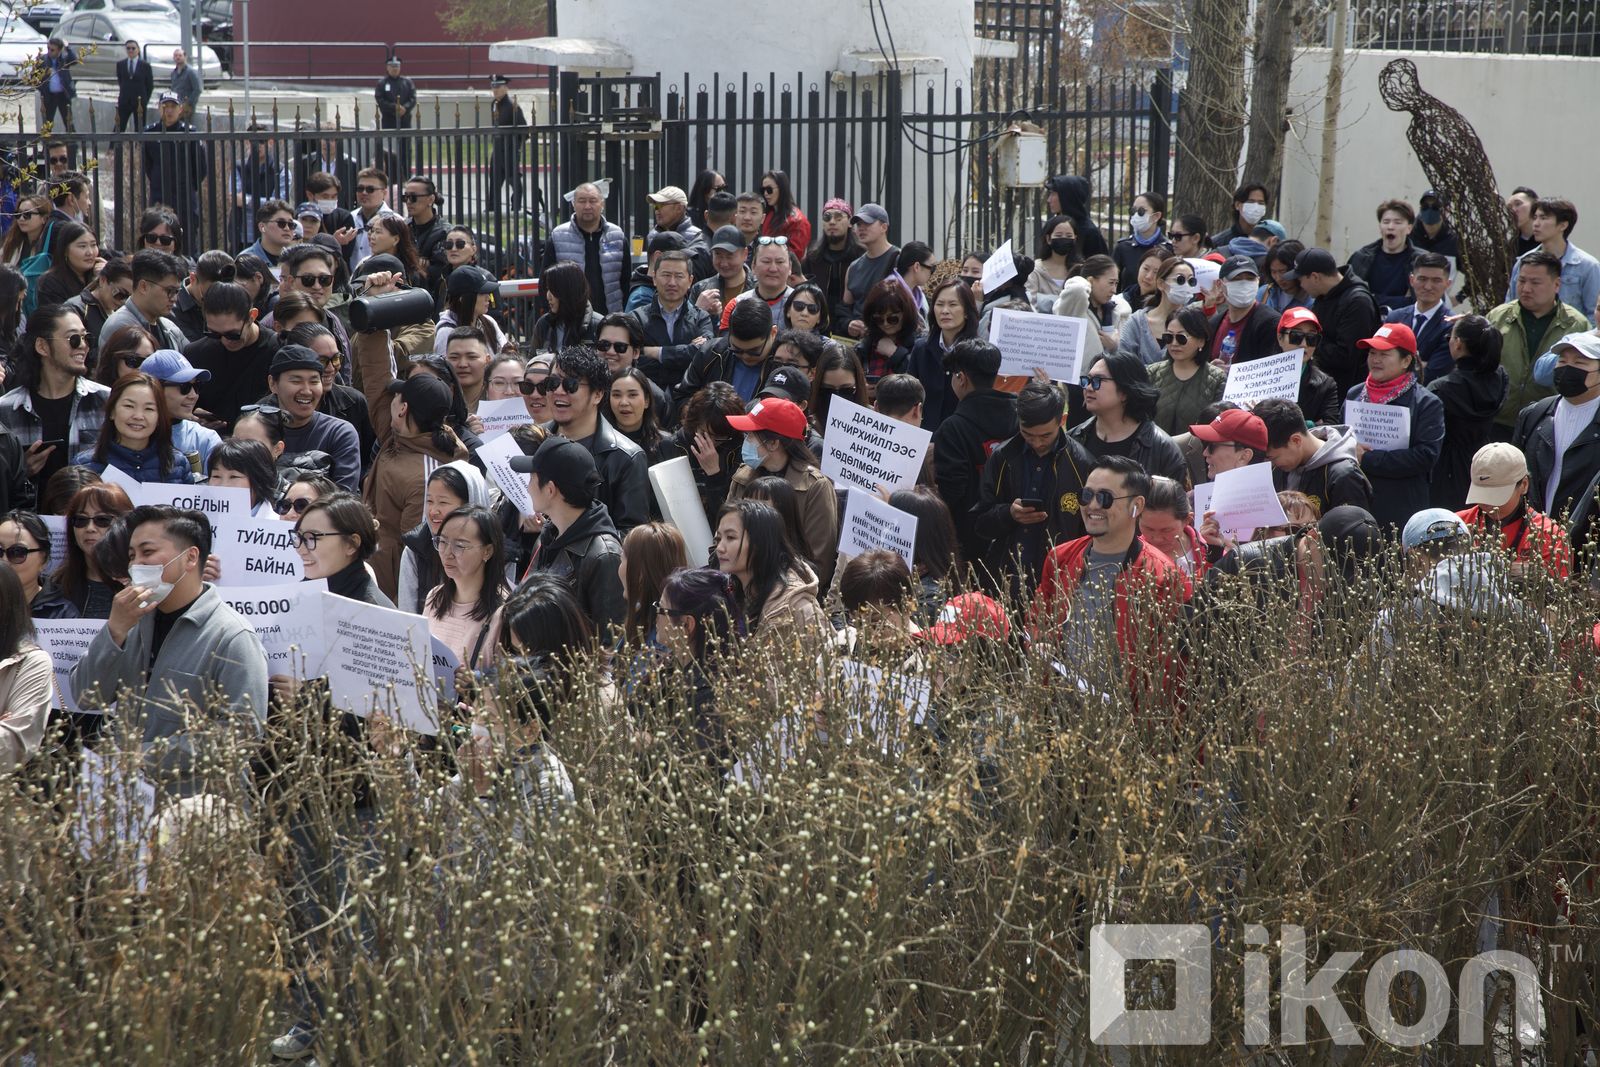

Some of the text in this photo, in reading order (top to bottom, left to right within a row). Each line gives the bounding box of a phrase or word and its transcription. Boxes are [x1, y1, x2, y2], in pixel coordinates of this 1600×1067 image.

[1273, 363, 1296, 376] ДООД
[1244, 376, 1284, 390] ХЭМЖЭЭГ
[852, 412, 896, 435] ДАРАМТ
[830, 417, 917, 458] ХҮЧИРХИЙЛЛЭЭС
[849, 442, 882, 464] АНГИД
[830, 446, 902, 484] ХӨДӨЛМӨРИЙГ
[172, 495, 230, 513] СОЁЛЫН
[245, 556, 296, 577] БАЙНА
[50, 639, 74, 647] ДАХИН
[53, 652, 78, 661] СОЁЛЫН
